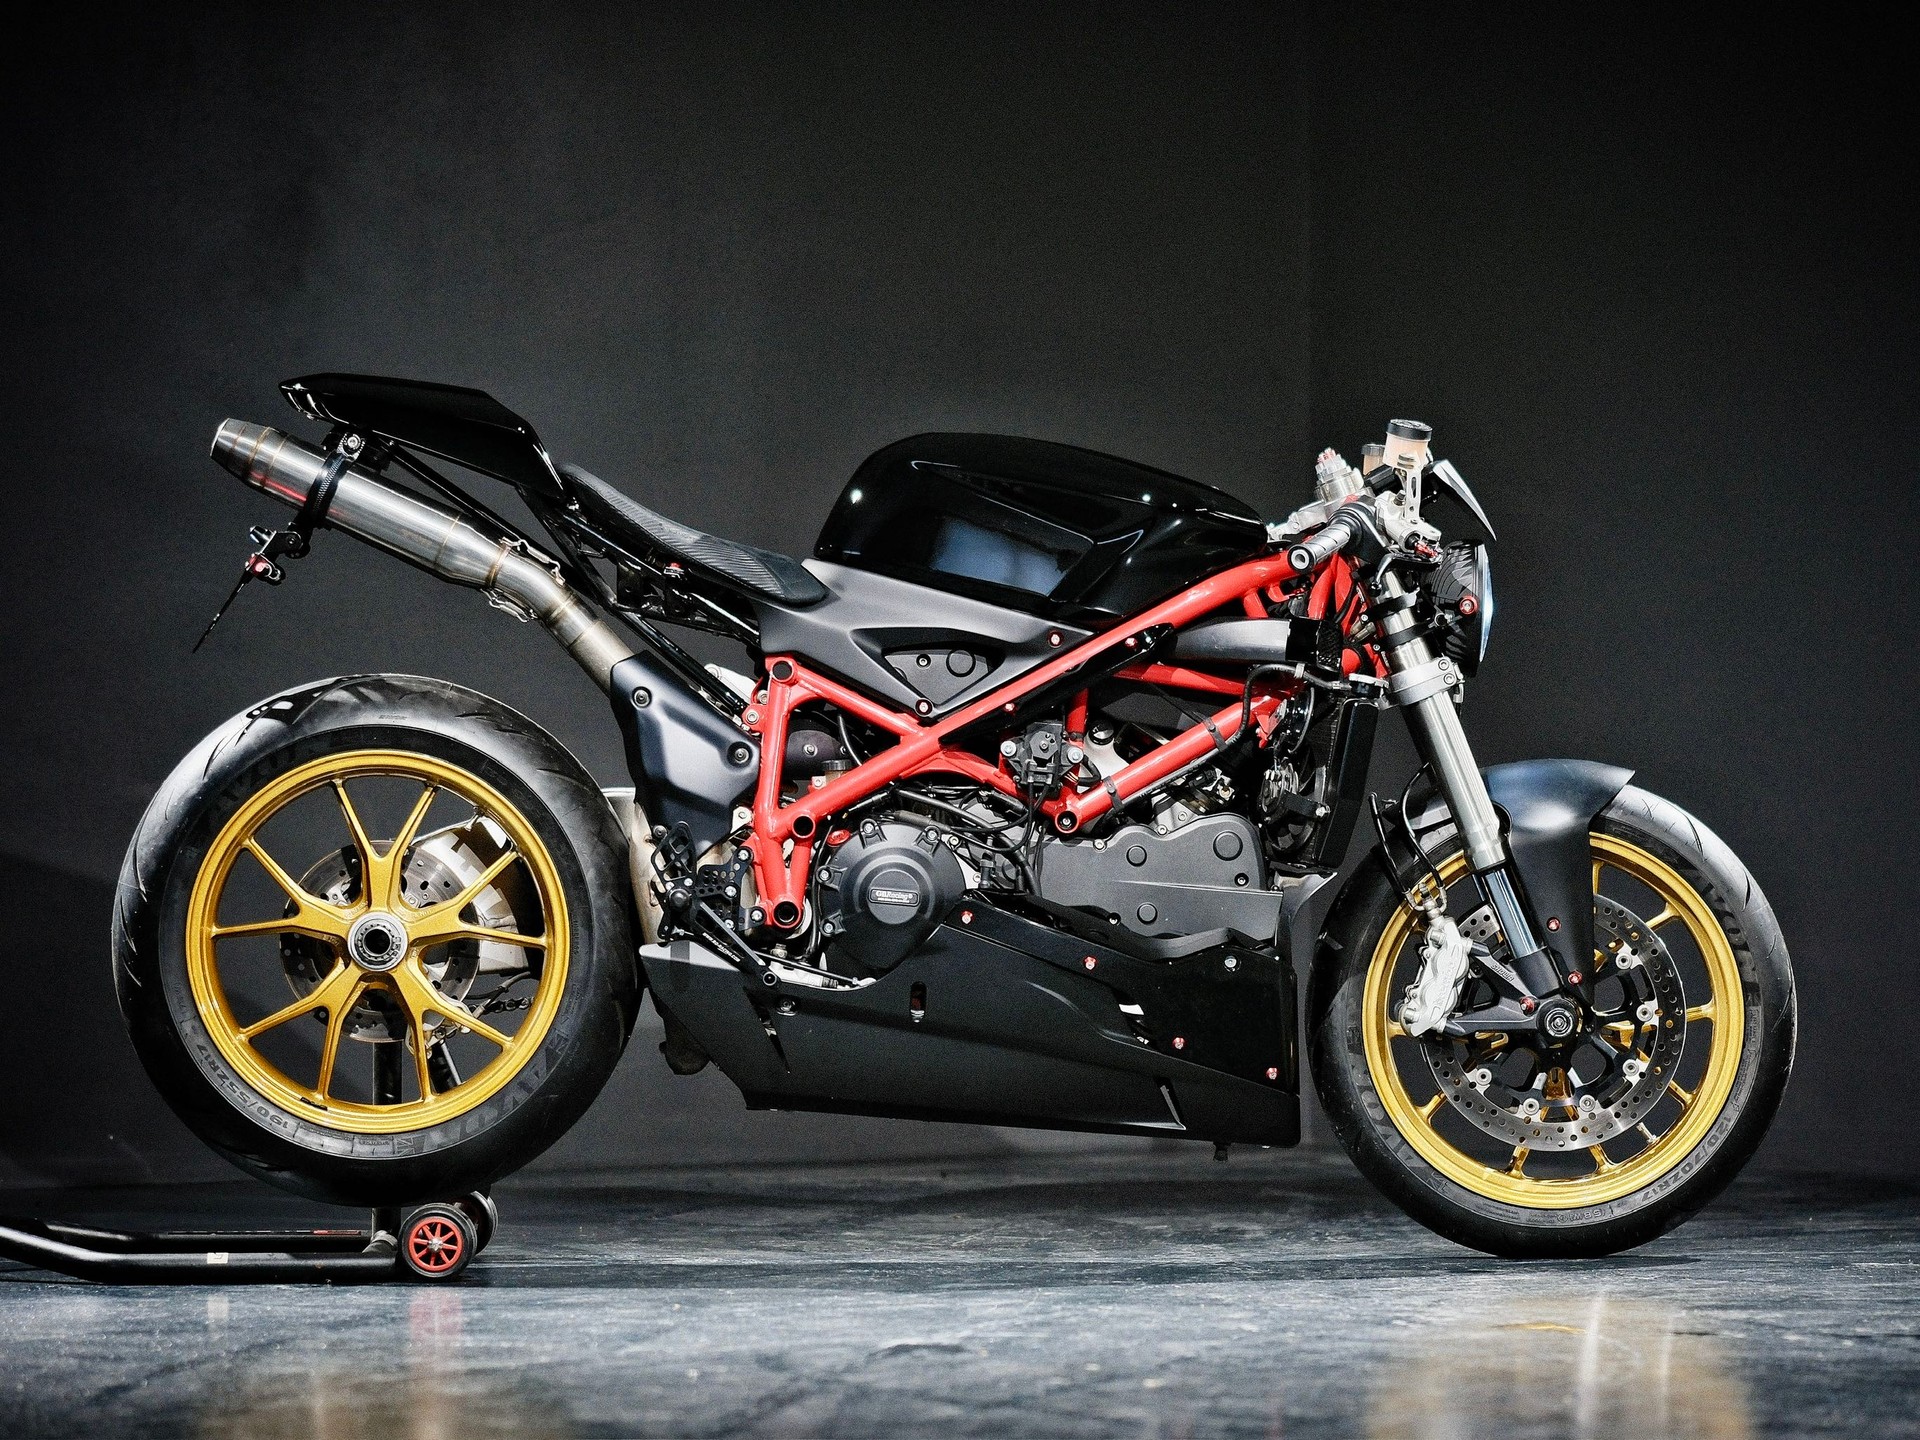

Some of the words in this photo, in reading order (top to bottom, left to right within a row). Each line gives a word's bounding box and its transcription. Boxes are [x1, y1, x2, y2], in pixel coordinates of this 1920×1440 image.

[196, 1043, 289, 1129] 190/55ZR17
[423, 1048, 548, 1151] AVON
[1348, 1052, 1431, 1168] AVON
[1641, 1116, 1732, 1202] 120/70ZR17
